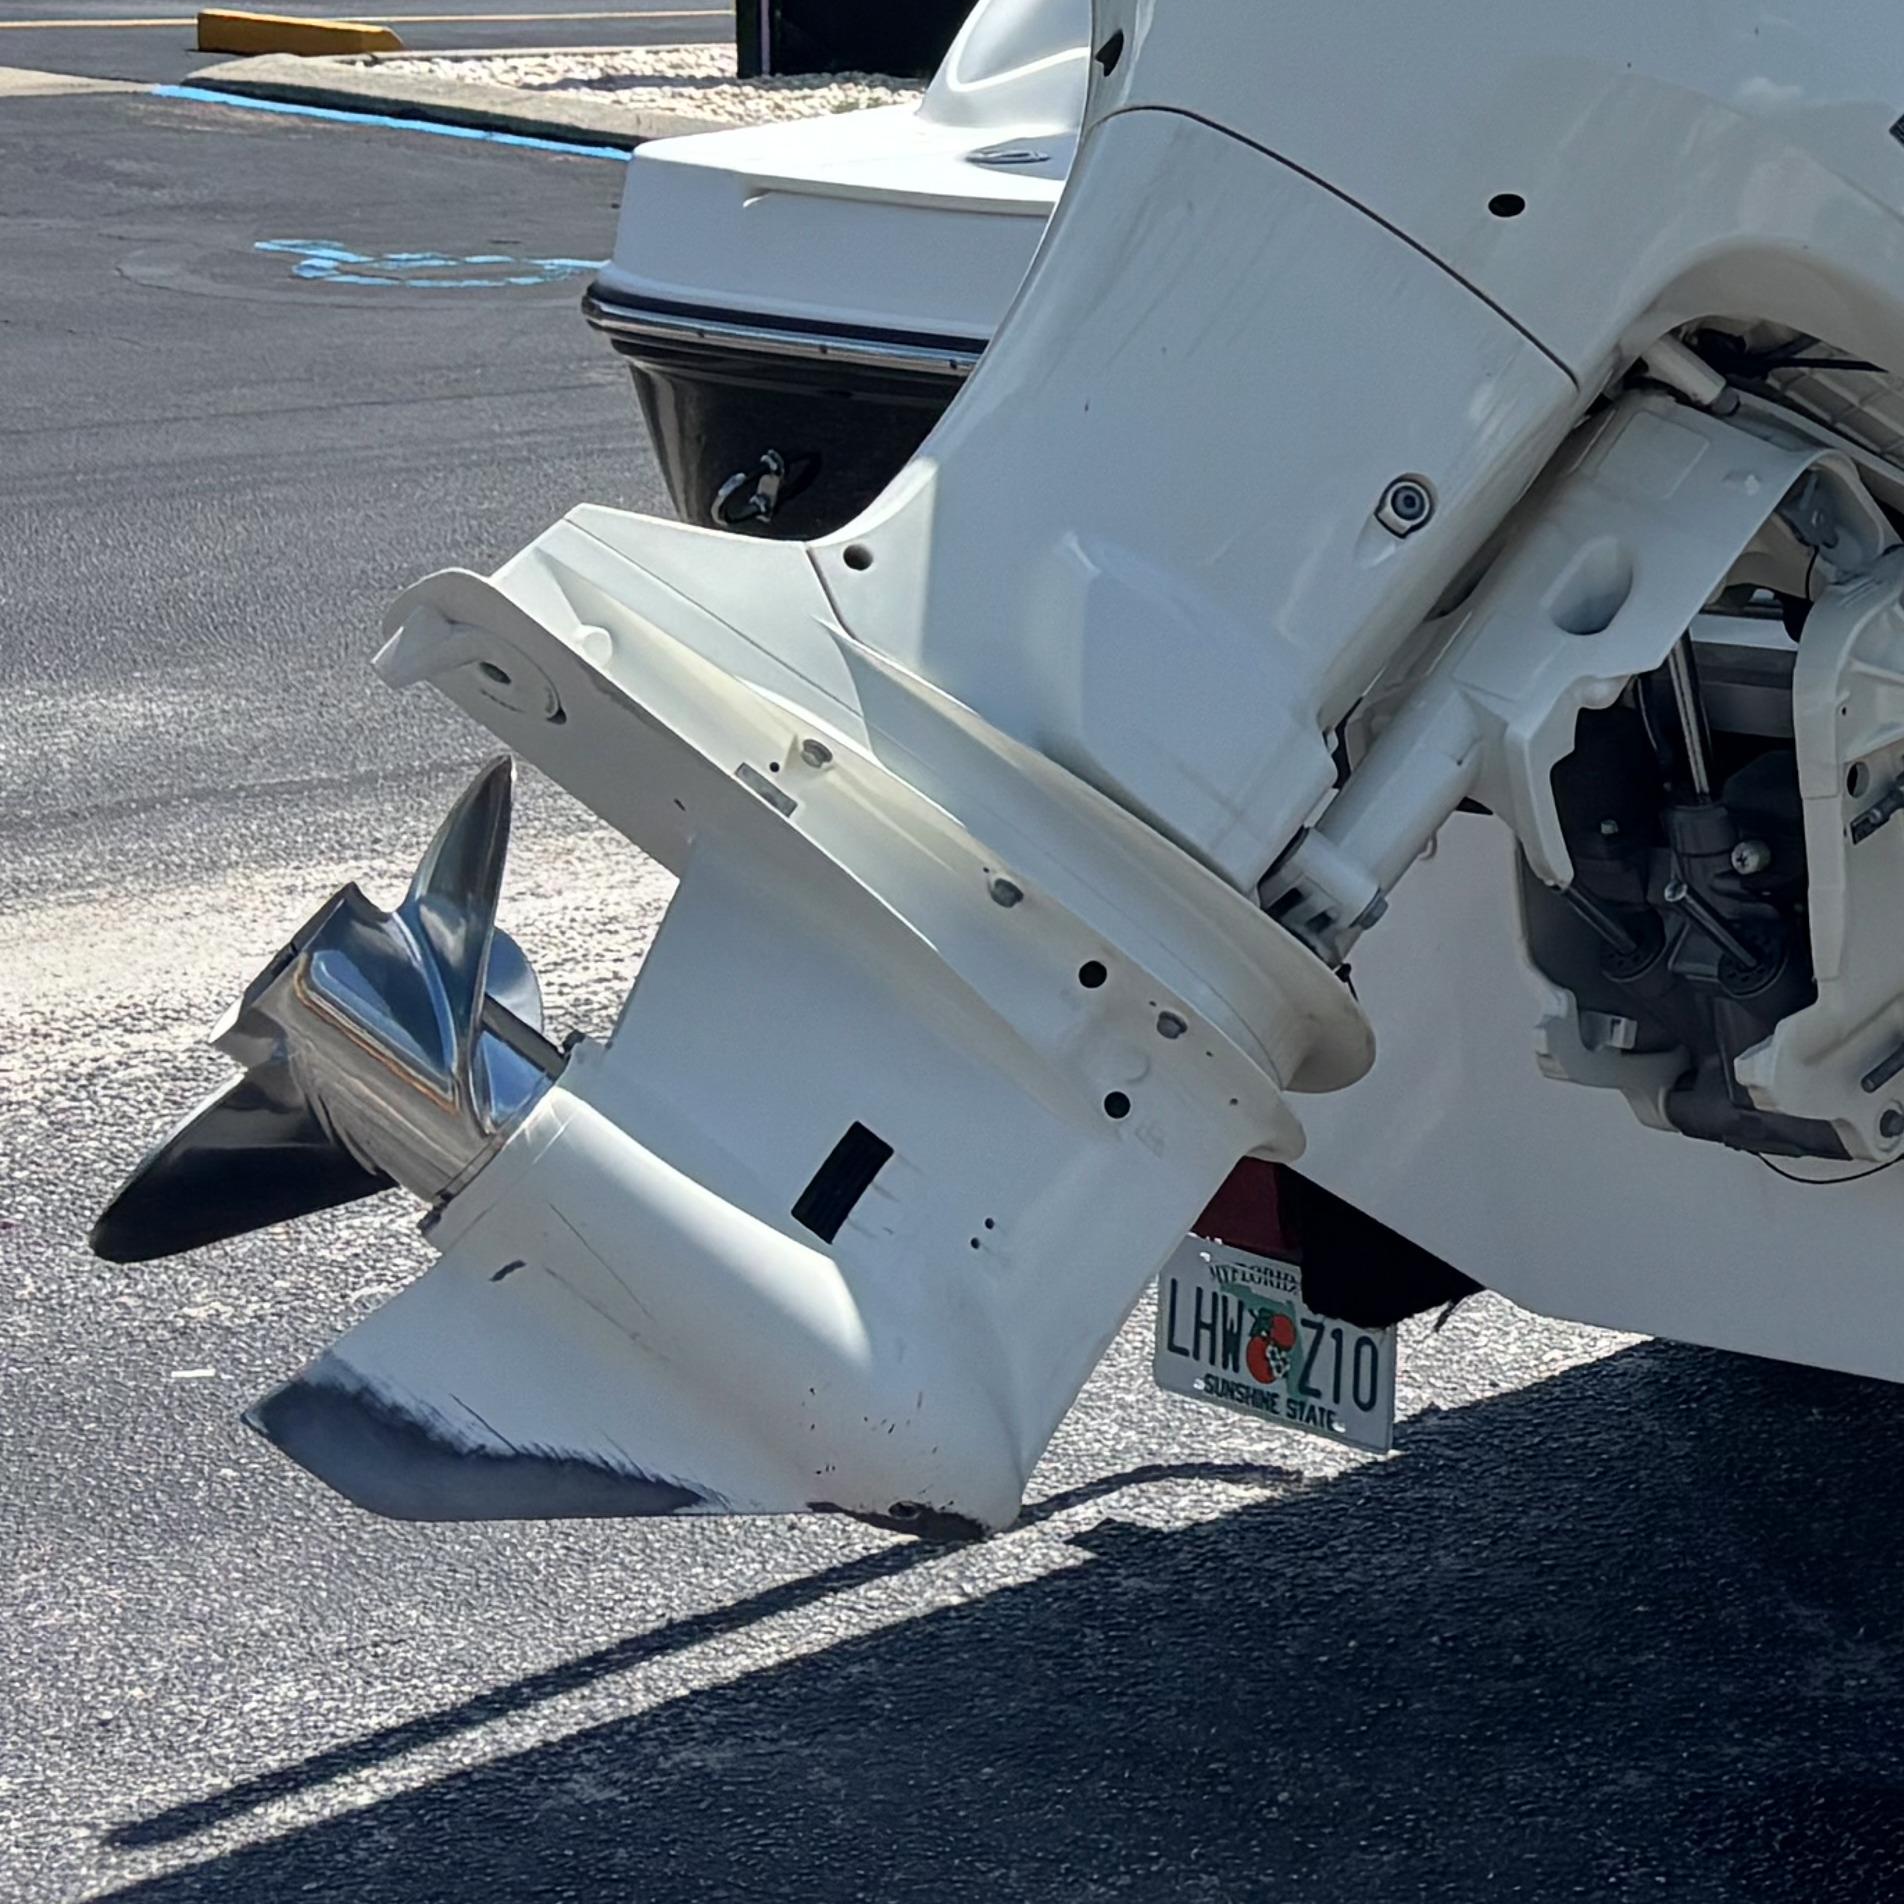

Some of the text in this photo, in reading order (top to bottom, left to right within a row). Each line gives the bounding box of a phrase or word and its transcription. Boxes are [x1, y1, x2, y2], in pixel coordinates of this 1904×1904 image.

[1167, 1278, 1379, 1413] LHW Z10
[1203, 1372, 1338, 1432] SUNSHINE STATE
